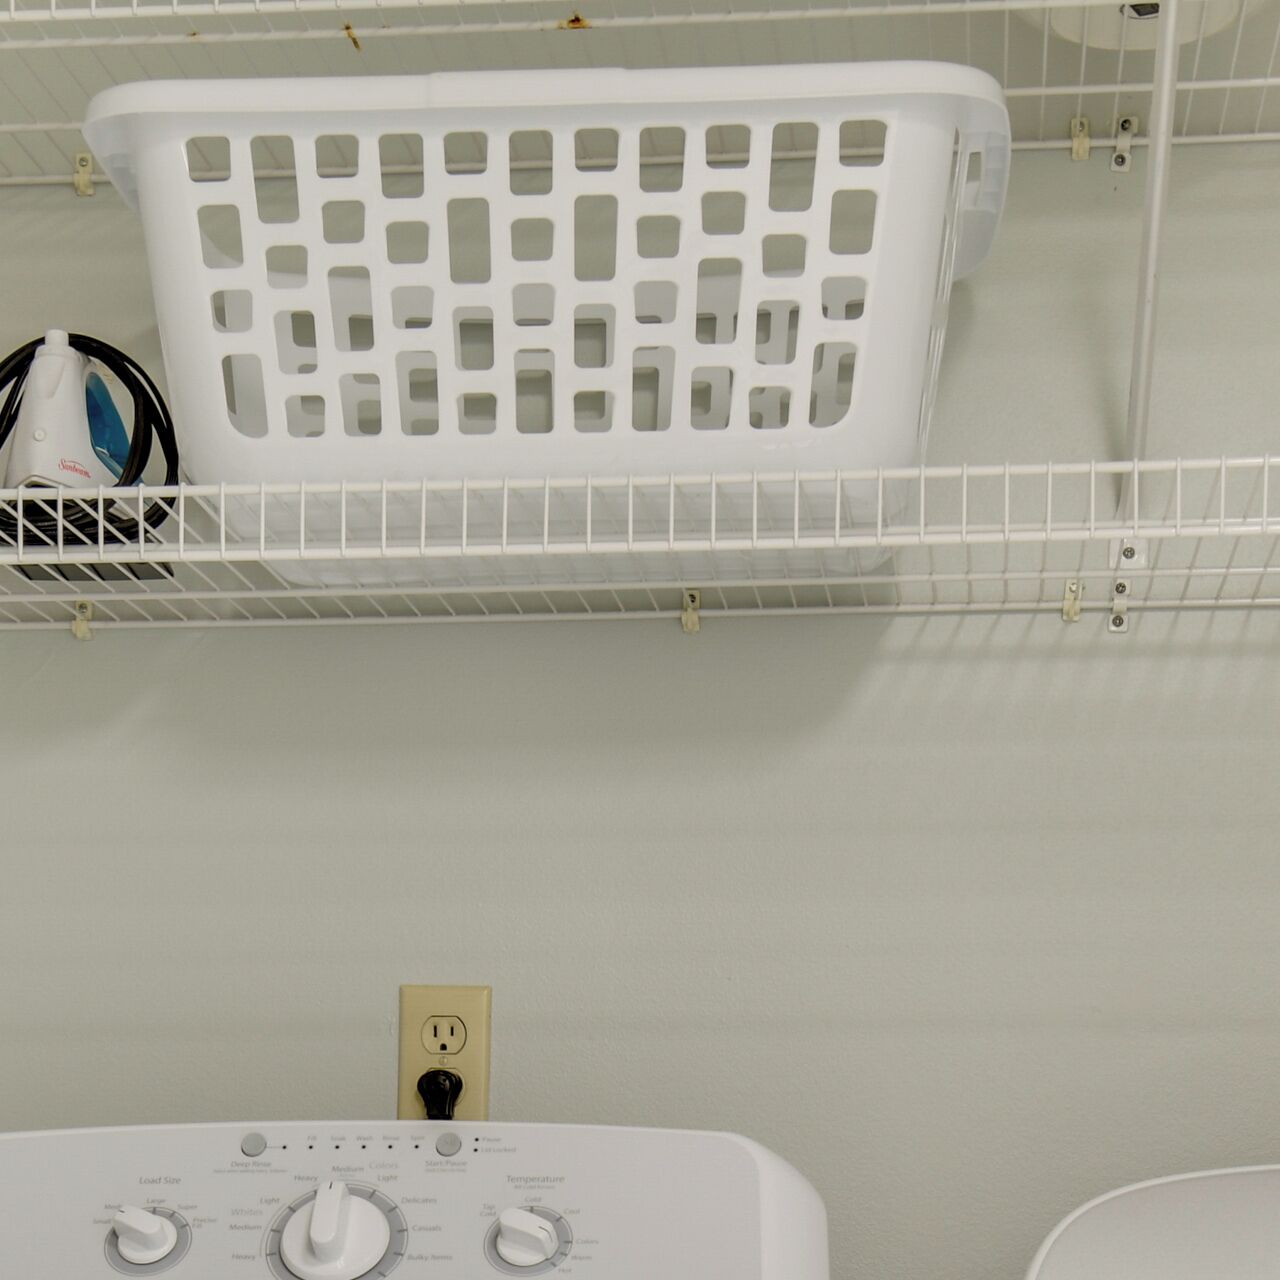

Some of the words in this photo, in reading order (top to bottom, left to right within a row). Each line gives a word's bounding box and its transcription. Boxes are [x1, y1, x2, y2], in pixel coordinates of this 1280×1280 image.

[230, 1161, 250, 1169] Deep
[331, 1165, 365, 1173] Medium
[368, 1160, 399, 1170] Colors
[139, 1176, 163, 1185] Load
[164, 1176, 182, 1185] Size
[294, 1174, 318, 1183] Heavy
[377, 1174, 399, 1183] Light
[506, 1174, 566, 1185] Temperature
[146, 1198, 166, 1206] Large
[260, 1197, 280, 1206] Light
[401, 1196, 438, 1204] Delicates
[483, 1203, 496, 1211] Tap
[230, 1208, 264, 1217] Whites
[480, 1210, 498, 1218] Cold
[229, 1223, 262, 1231] Medium
[411, 1224, 442, 1232] Casuals
[231, 1252, 256, 1262] Heavy
[407, 1253, 430, 1262] Bulky
